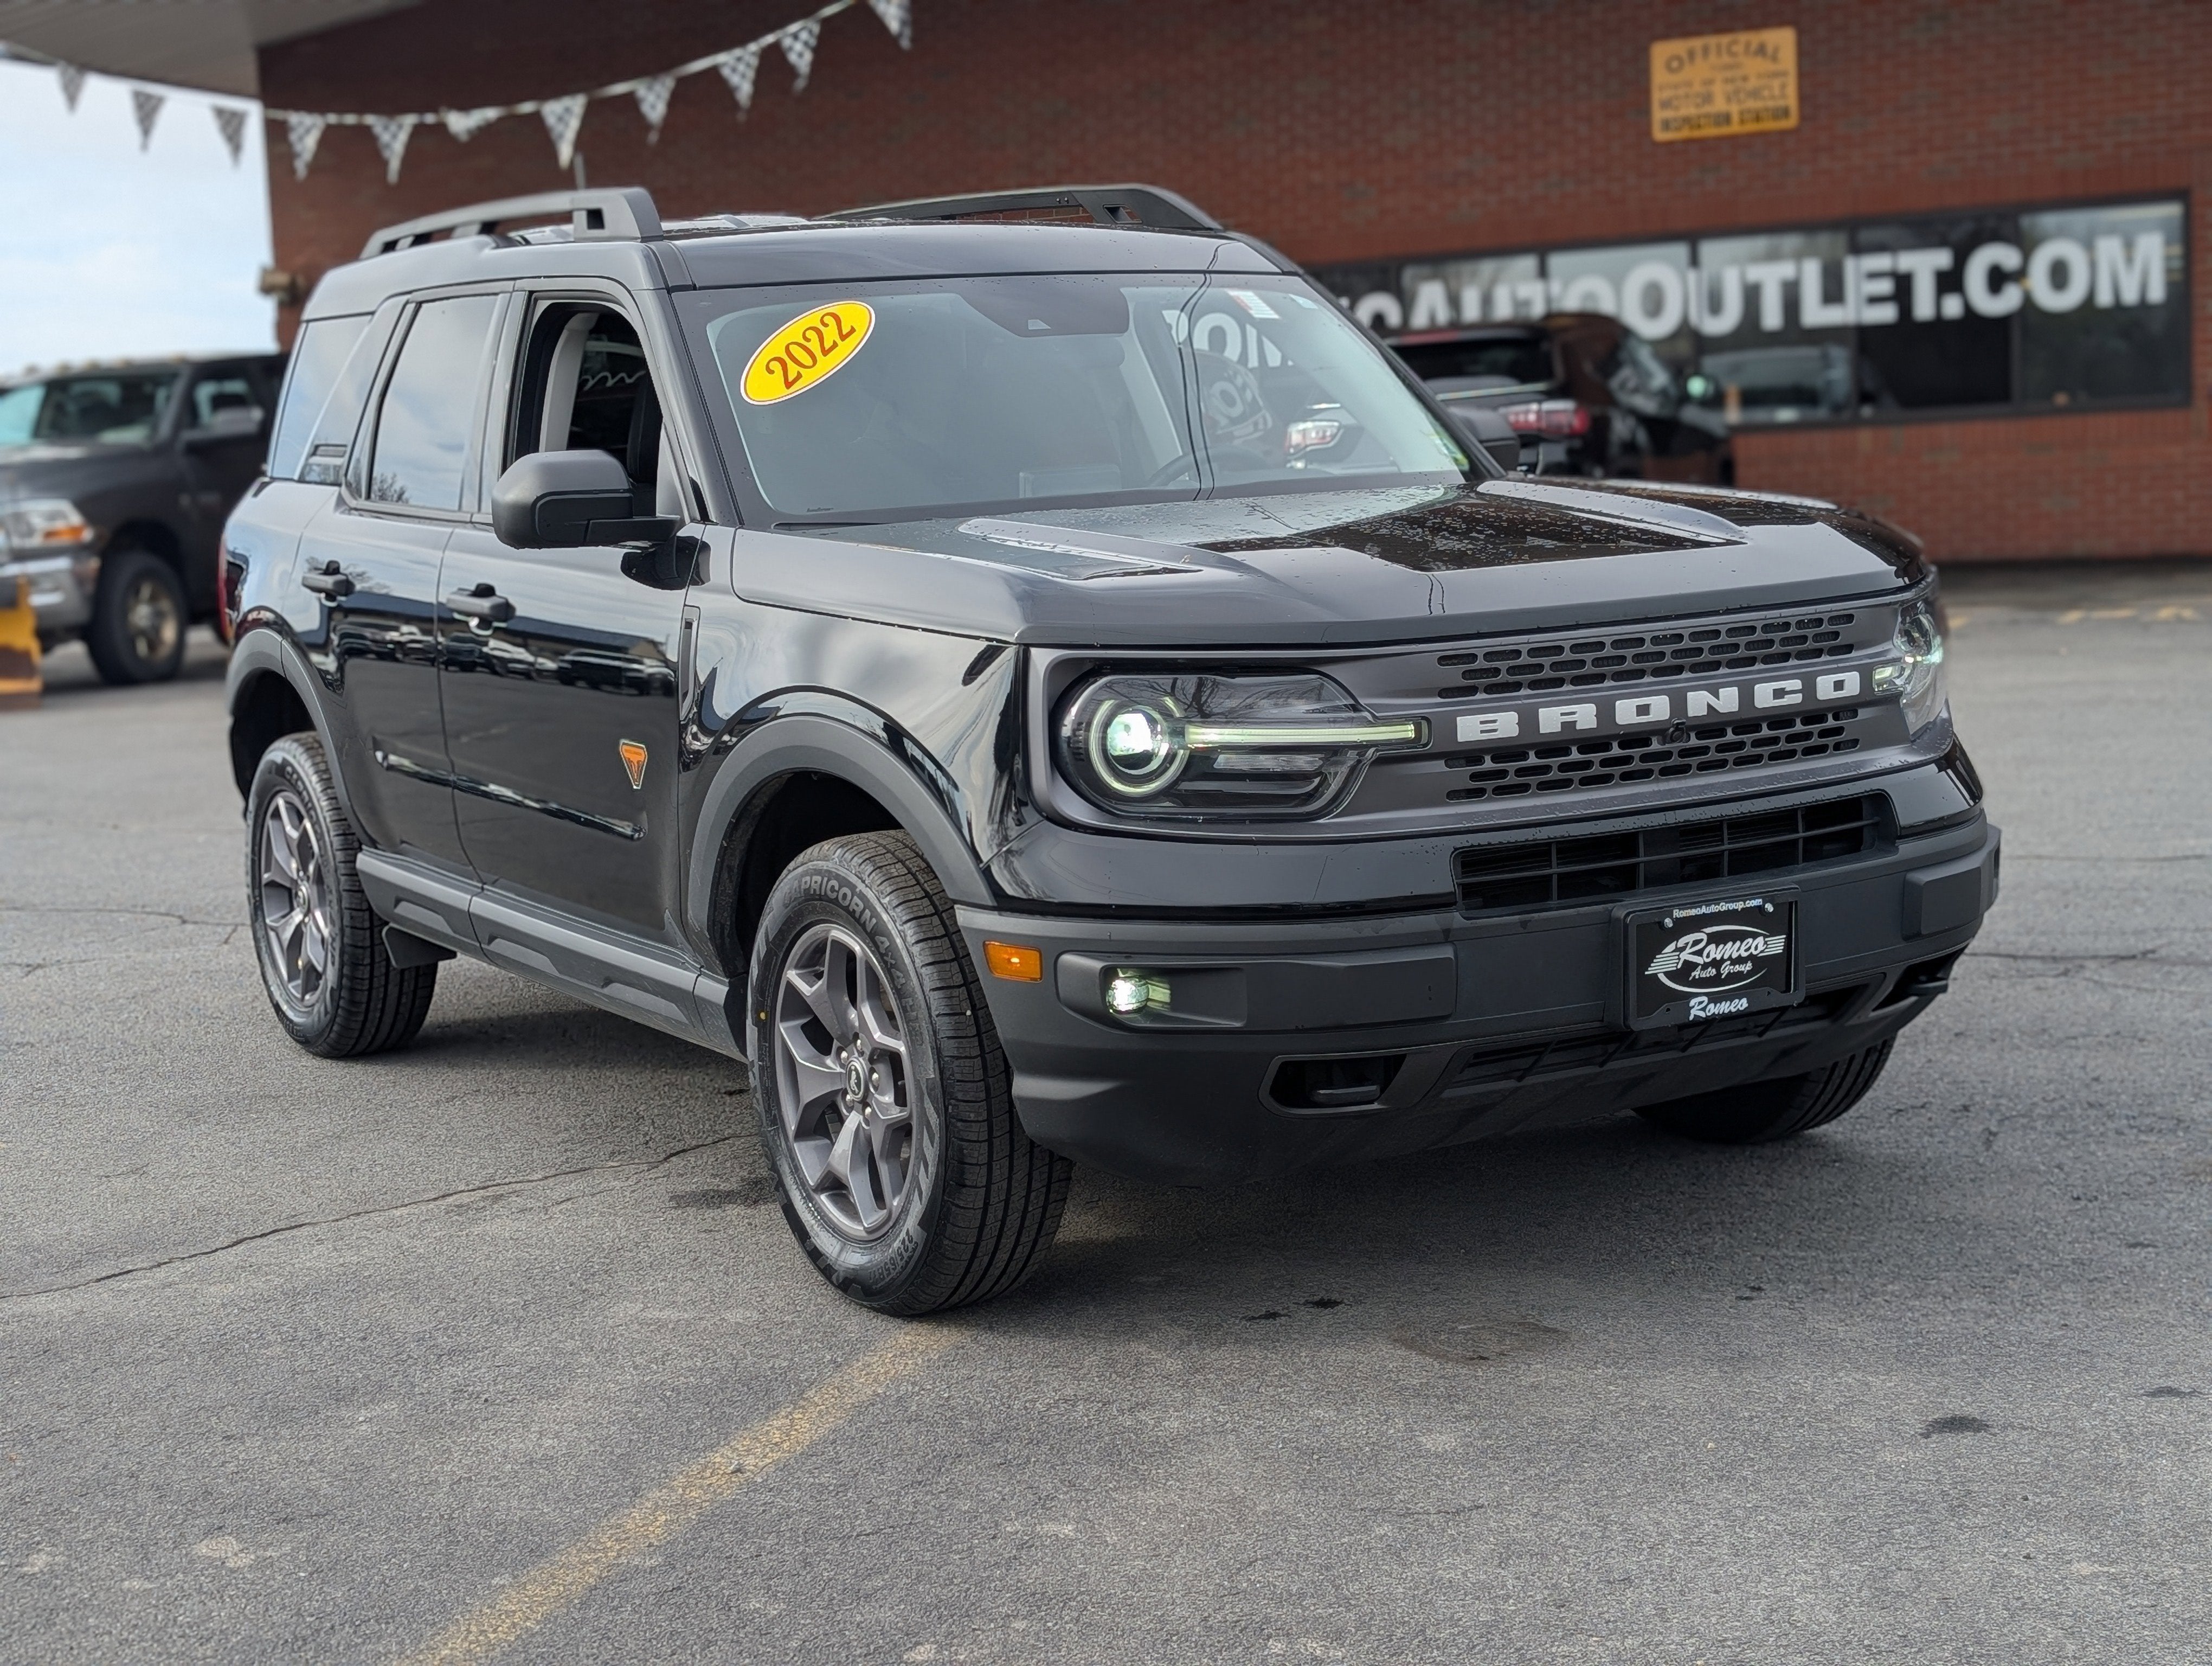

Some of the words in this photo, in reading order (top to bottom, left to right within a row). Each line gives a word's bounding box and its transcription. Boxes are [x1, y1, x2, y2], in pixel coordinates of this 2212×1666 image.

[1666, 38, 1780, 74] OFFICIAL
[765, 312, 857, 390] 2022
[1456, 671, 1860, 742] BRONCO
[785, 875, 877, 933] CAPRICORN
[1673, 899, 1763, 918] RomeoAutoGroup.com
[1677, 932, 1767, 969] Romeo
[1689, 965, 1717, 981] Auto
[1720, 960, 1753, 979] Group
[1689, 996, 1748, 1021] Romeo
